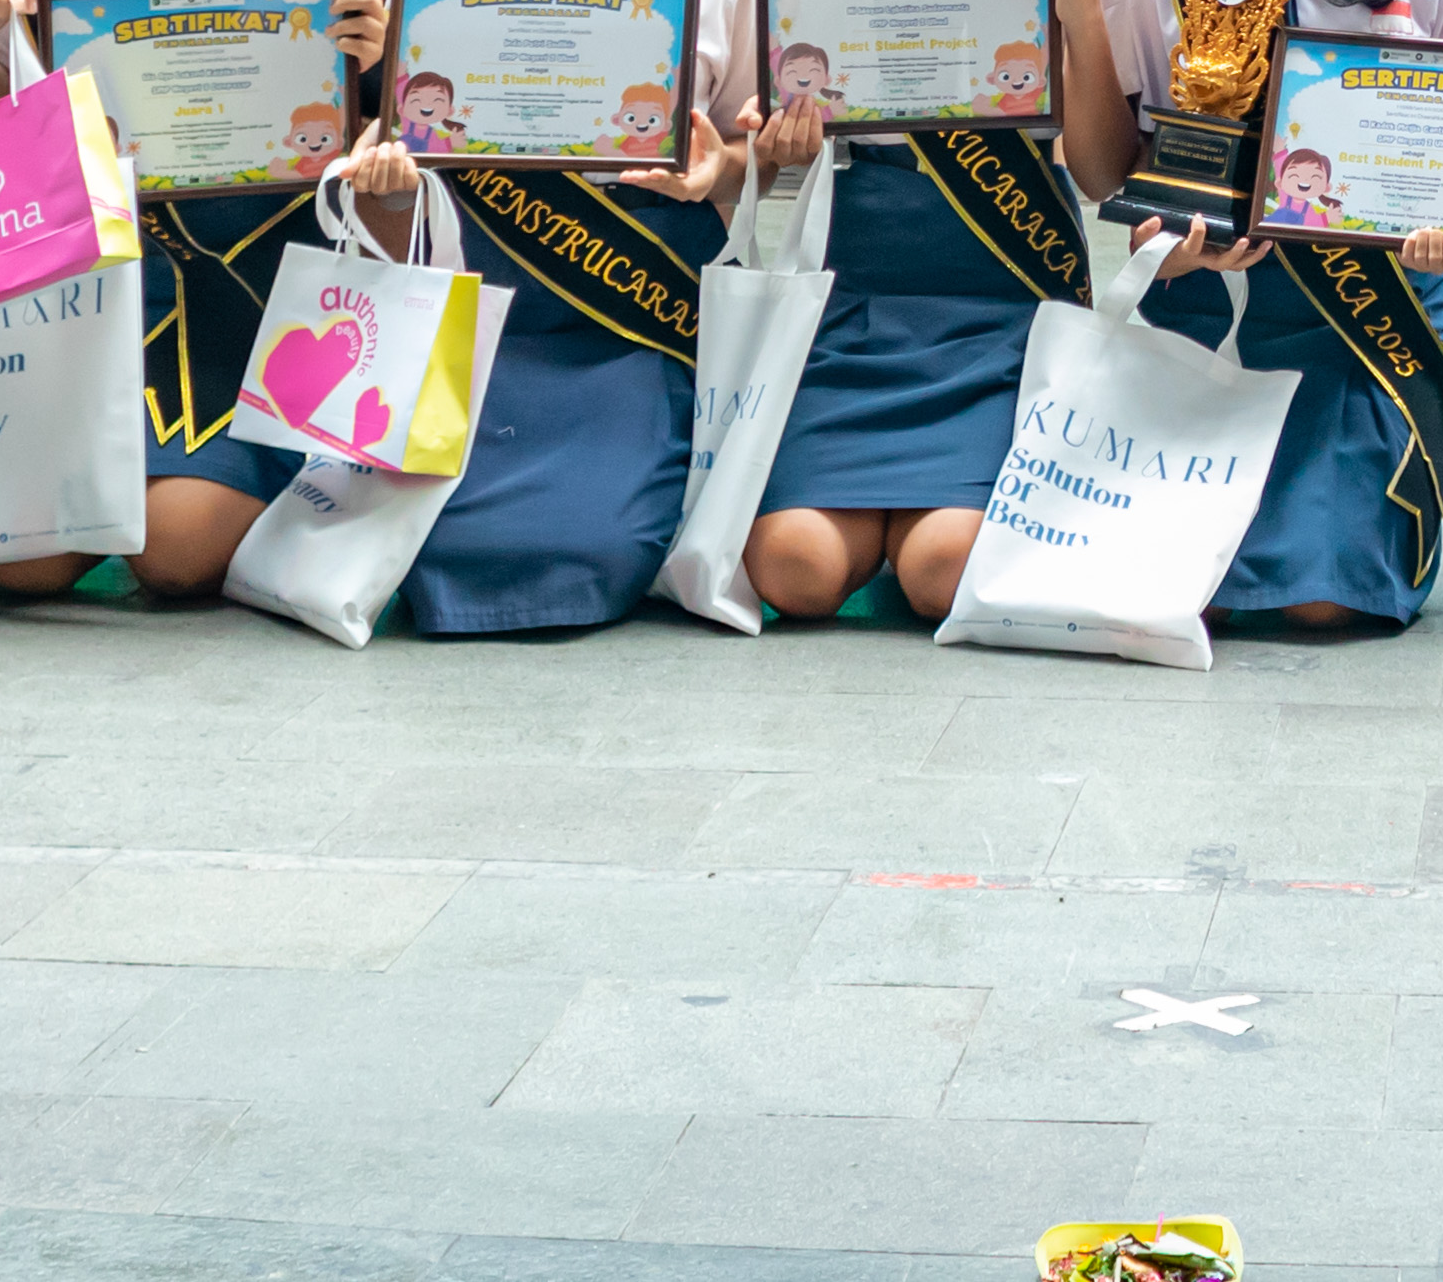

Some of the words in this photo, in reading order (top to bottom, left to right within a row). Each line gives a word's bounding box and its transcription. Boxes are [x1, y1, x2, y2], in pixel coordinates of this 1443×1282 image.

[114, 10, 286, 43] SERTIFIKAT
[840, 41, 869, 53] Best
[876, 39, 925, 51] Student
[930, 37, 978, 50] Project
[466, 73, 497, 85] Best
[502, 74, 551, 86] Student
[557, 75, 606, 88] Project
[1339, 152, 1369, 165] Best
[1374, 154, 1424, 170] Student
[320, 284, 379, 377] authentic
[335, 325, 360, 361] beauty
[1363, 316, 1422, 379] 2025
[1021, 399, 1239, 486] KUMARI
[998, 473, 1037, 505] Of
[1007, 447, 1132, 510] Solution
[986, 500, 1091, 547] Beauty
